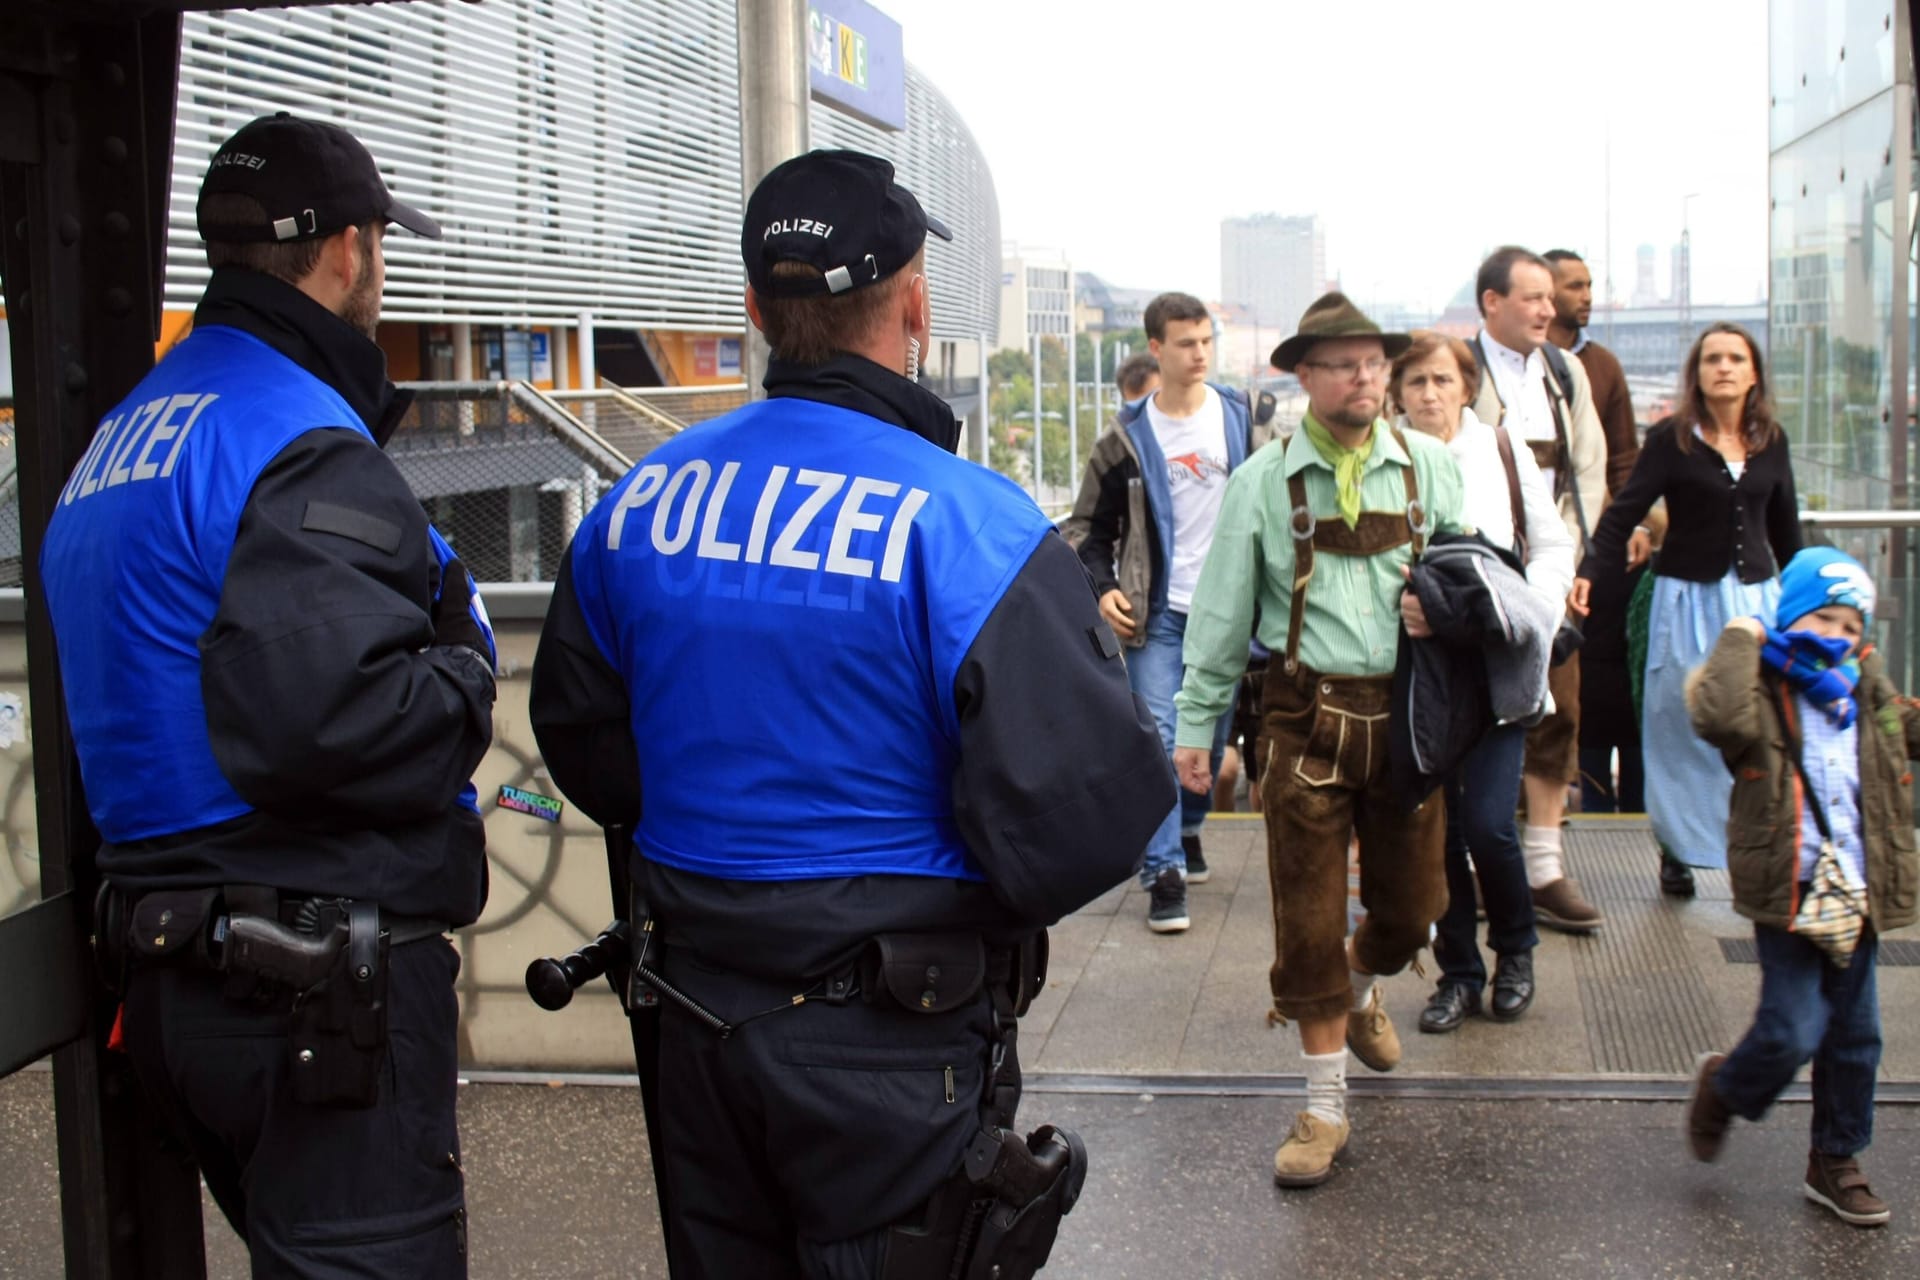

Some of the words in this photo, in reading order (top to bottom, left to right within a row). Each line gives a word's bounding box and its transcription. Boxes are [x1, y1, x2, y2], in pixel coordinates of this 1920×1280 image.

[212, 152, 267, 170] OLIZEI
[56, 393, 221, 510] OLIZEI
[607, 459, 931, 583] POLIZEI
[498, 795, 530, 815] LIKES
[502, 786, 562, 813] TURECKI
